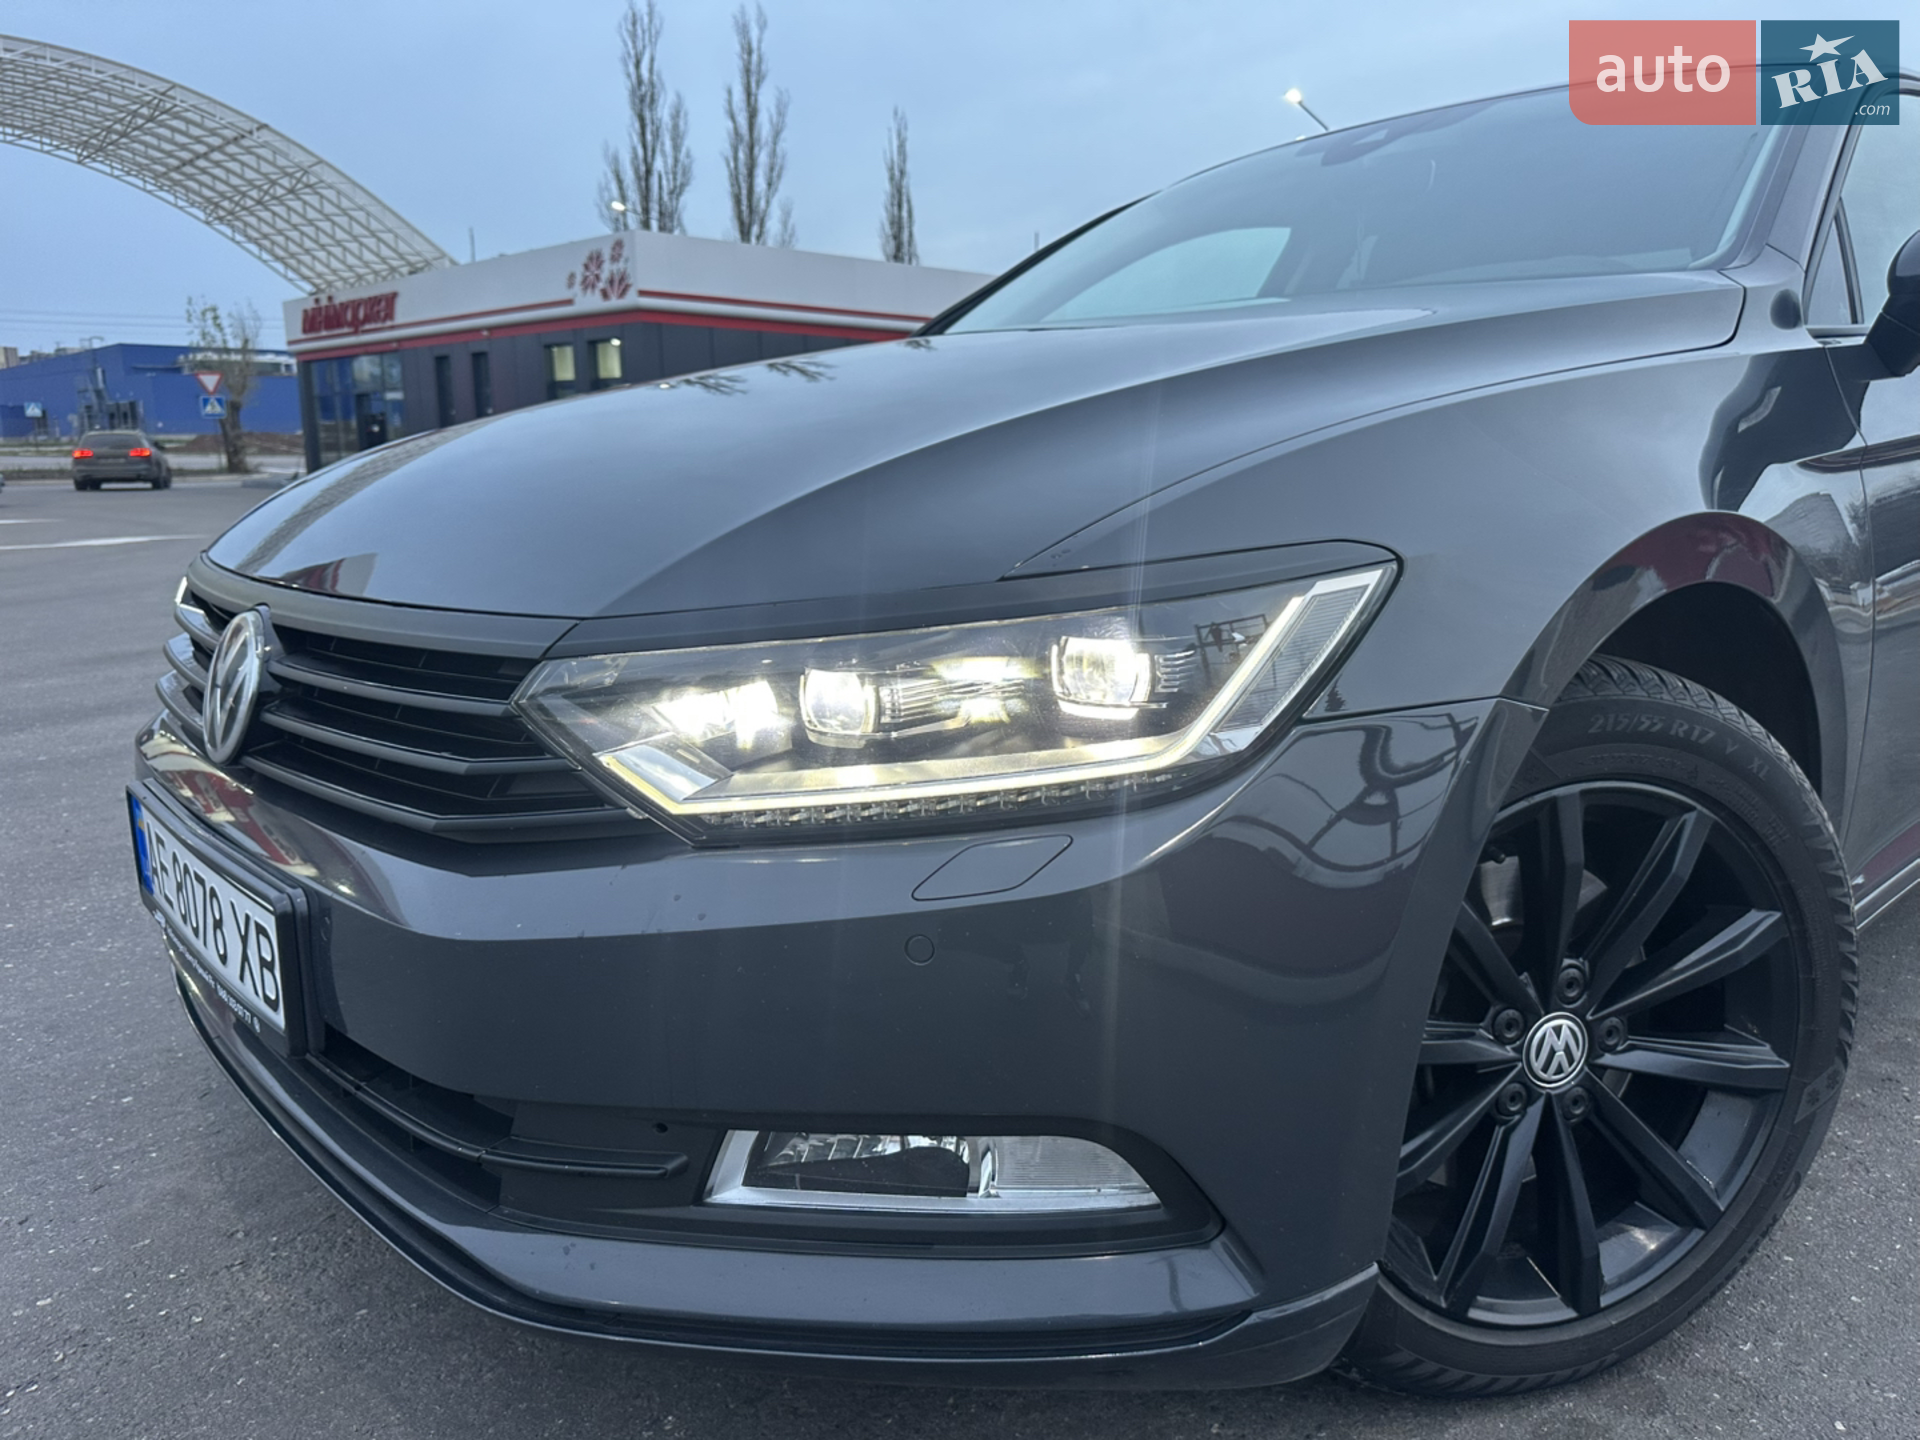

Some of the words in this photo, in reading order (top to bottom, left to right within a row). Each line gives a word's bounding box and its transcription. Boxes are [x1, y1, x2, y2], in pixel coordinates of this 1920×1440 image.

[146, 822, 175, 910] AE
[172, 851, 228, 967] 8078
[230, 899, 281, 1013] XB
